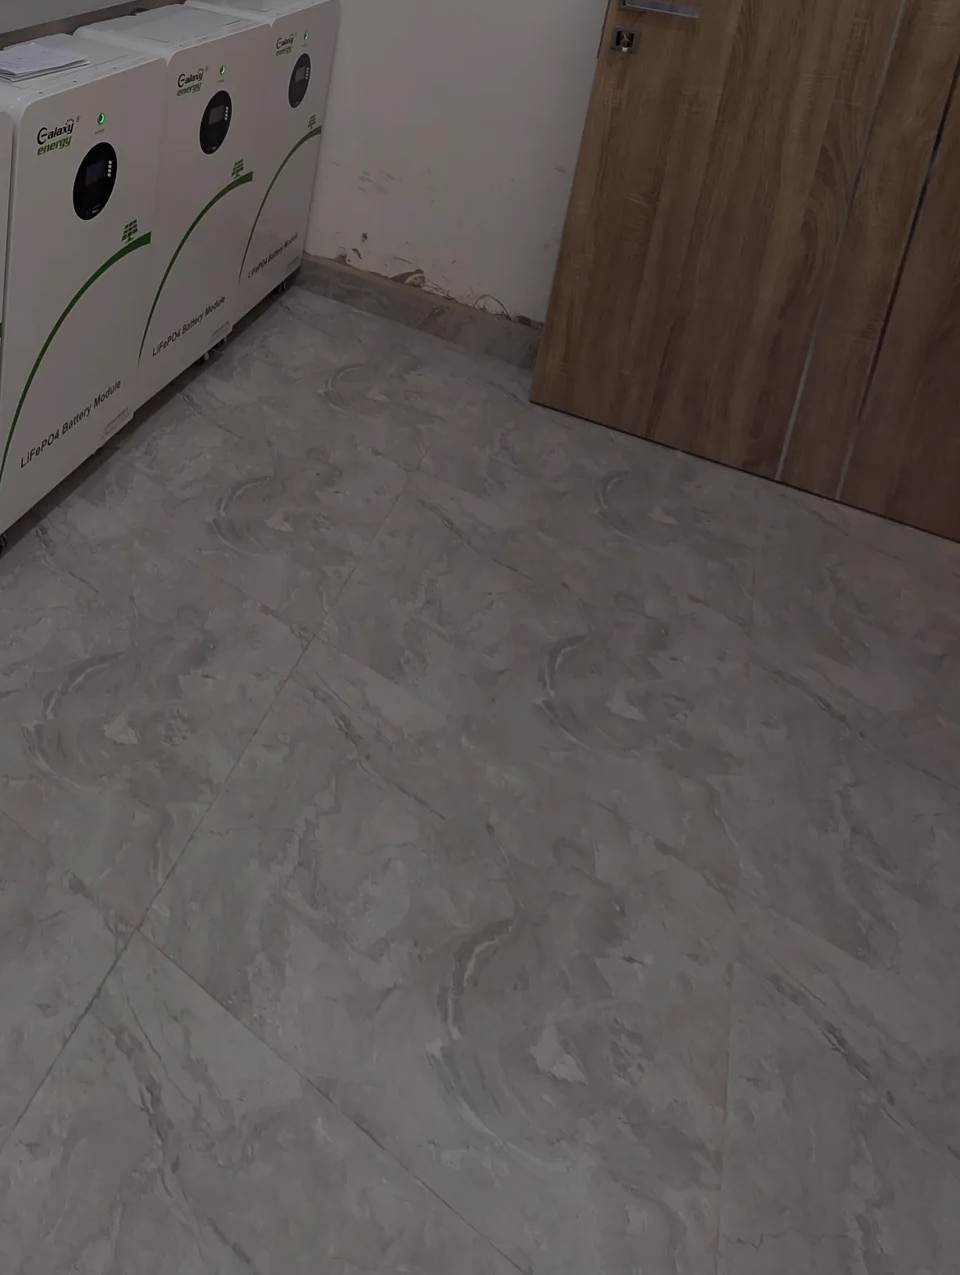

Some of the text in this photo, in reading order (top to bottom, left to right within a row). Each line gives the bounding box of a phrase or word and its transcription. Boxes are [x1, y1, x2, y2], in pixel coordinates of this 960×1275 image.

[176, 83, 202, 96] energy
[177, 70, 204, 88] Galaxy
[37, 120, 75, 145] Galaxy
[37, 136, 72, 156] energy
[182, 312, 204, 335] Battery
[20, 428, 60, 469] LiFePO4
[62, 404, 92, 436] Battery
[93, 380, 122, 409] Module
